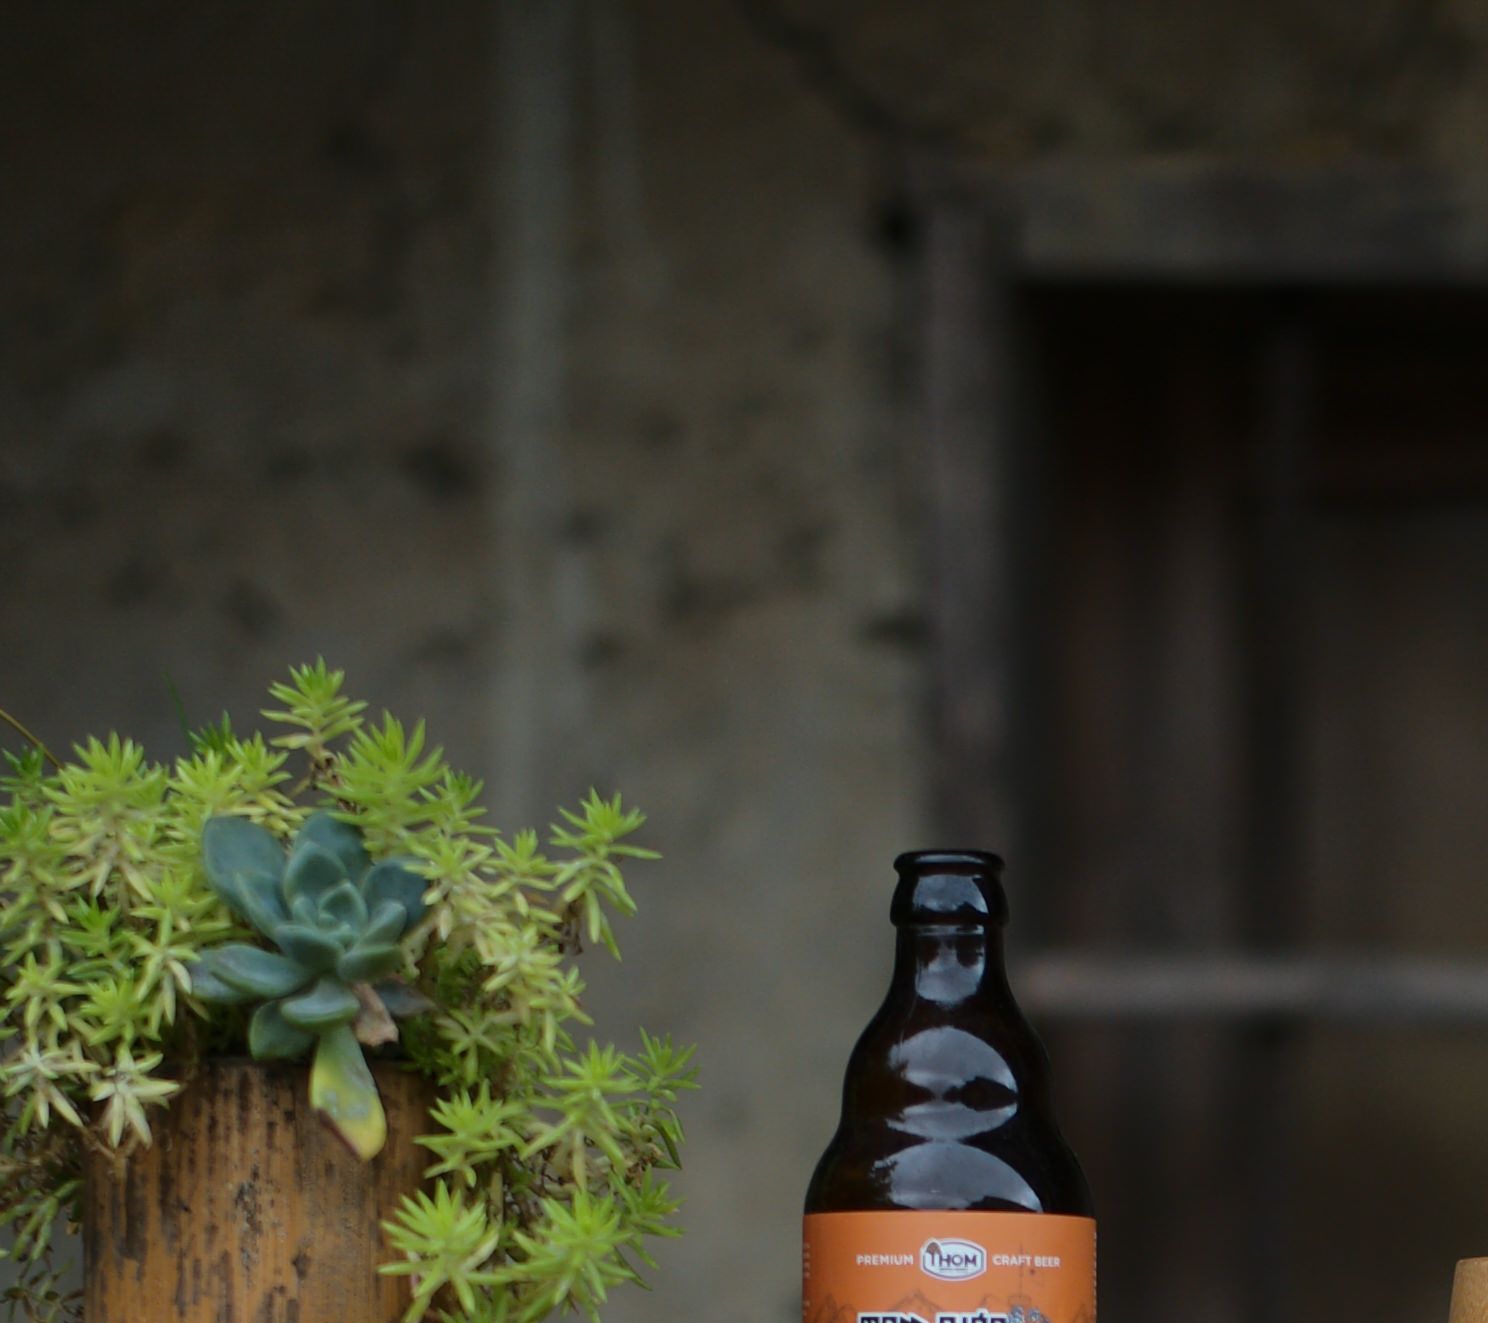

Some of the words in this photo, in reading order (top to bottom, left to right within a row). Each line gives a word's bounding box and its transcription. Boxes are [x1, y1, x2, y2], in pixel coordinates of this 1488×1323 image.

[856, 1254, 914, 1266] PREMIUM
[992, 1254, 1033, 1267] CRAFT
[1034, 1256, 1061, 1268] BEER
